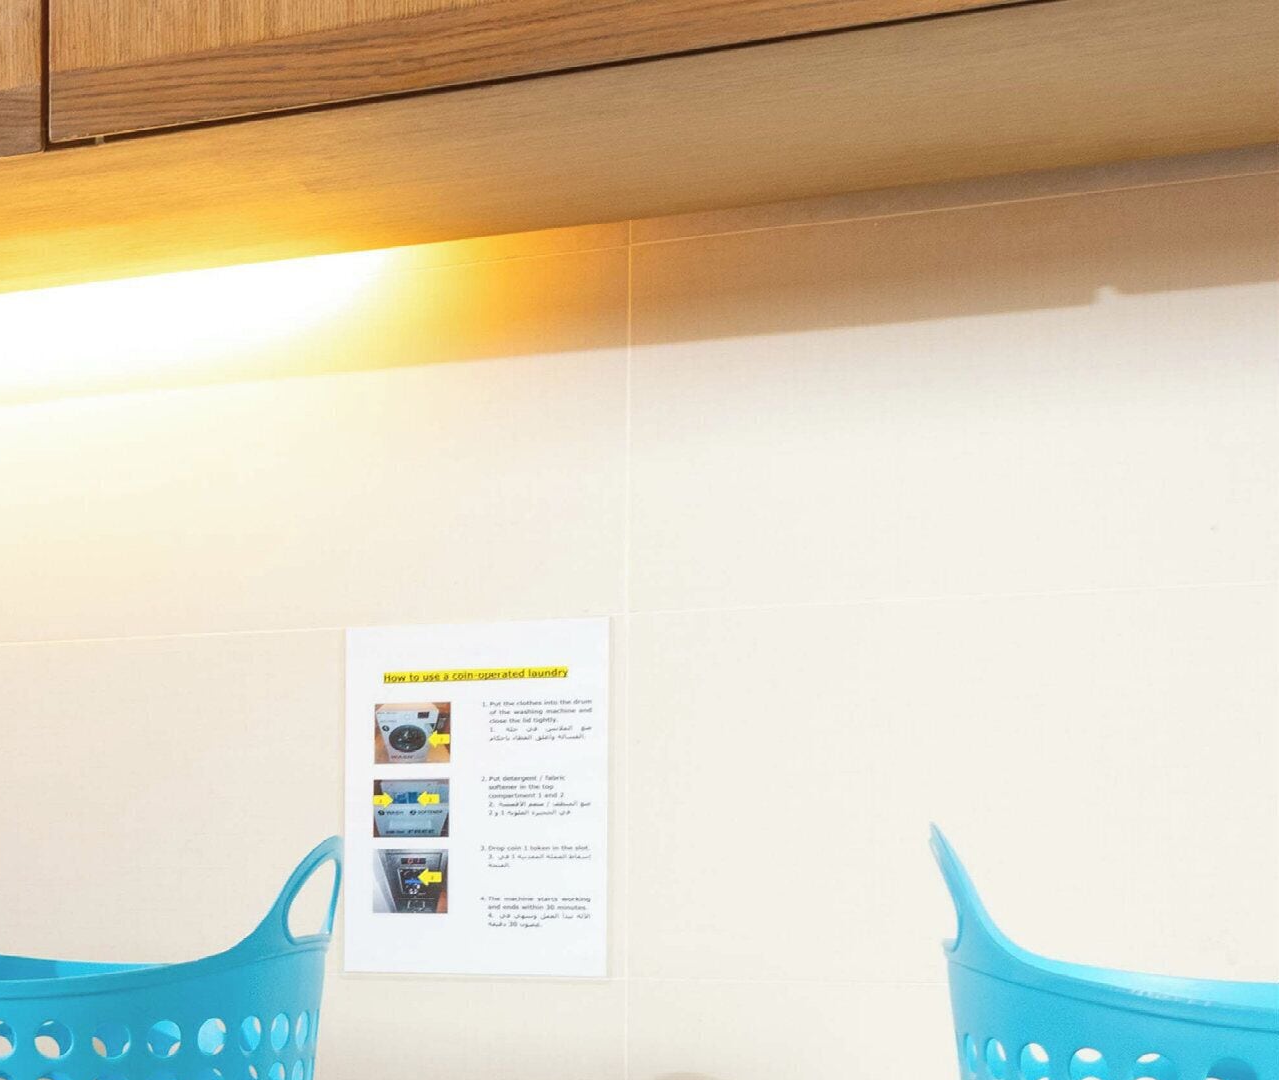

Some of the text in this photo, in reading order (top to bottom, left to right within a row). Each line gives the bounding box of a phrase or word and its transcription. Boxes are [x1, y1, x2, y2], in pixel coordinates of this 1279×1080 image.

[384, 673, 406, 683] How
[409, 674, 419, 682] to
[423, 674, 440, 682] use
[452, 669, 525, 681] coin-operated
[528, 668, 569, 679] laundry
